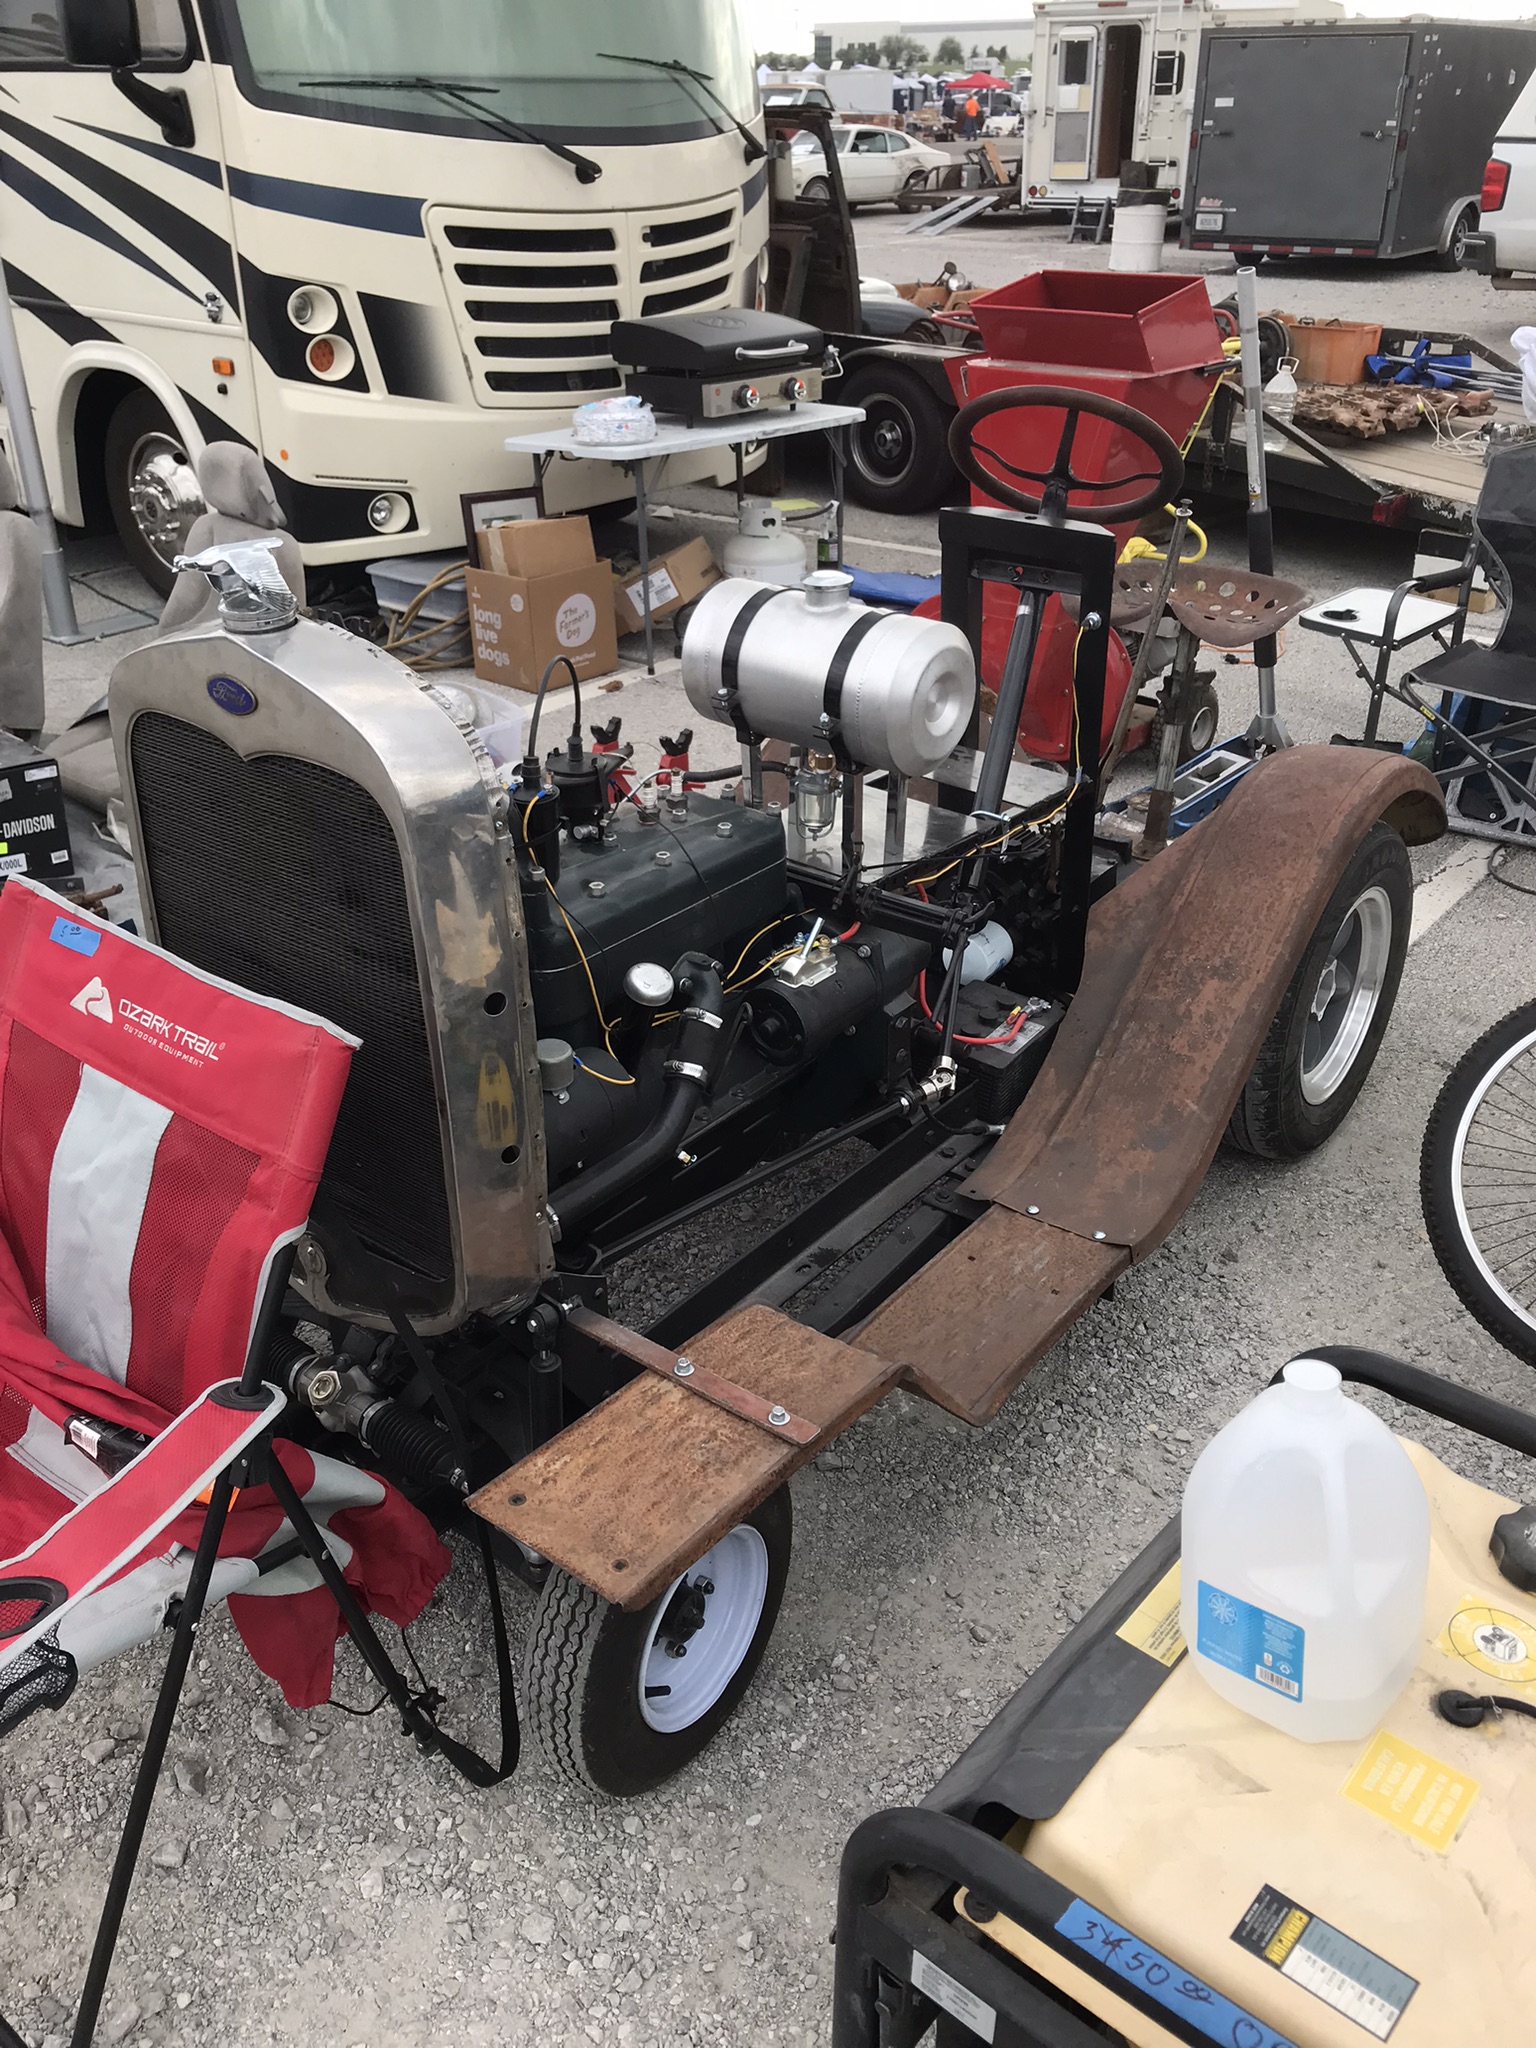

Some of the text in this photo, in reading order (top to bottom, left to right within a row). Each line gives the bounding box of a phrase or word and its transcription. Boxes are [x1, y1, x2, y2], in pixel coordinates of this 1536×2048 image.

[473, 603, 502, 630] long
[560, 609, 590, 633] Farmer's
[563, 607, 578, 618] The
[475, 622, 499, 644] live
[567, 627, 580, 640] Dog
[478, 643, 510, 667] dogs
[118, 999, 173, 1038] OZARK
[123, 1023, 205, 1068] OUTDOOR EQUIPMENT
[1264, 1908, 1310, 1966] CHAMPION
